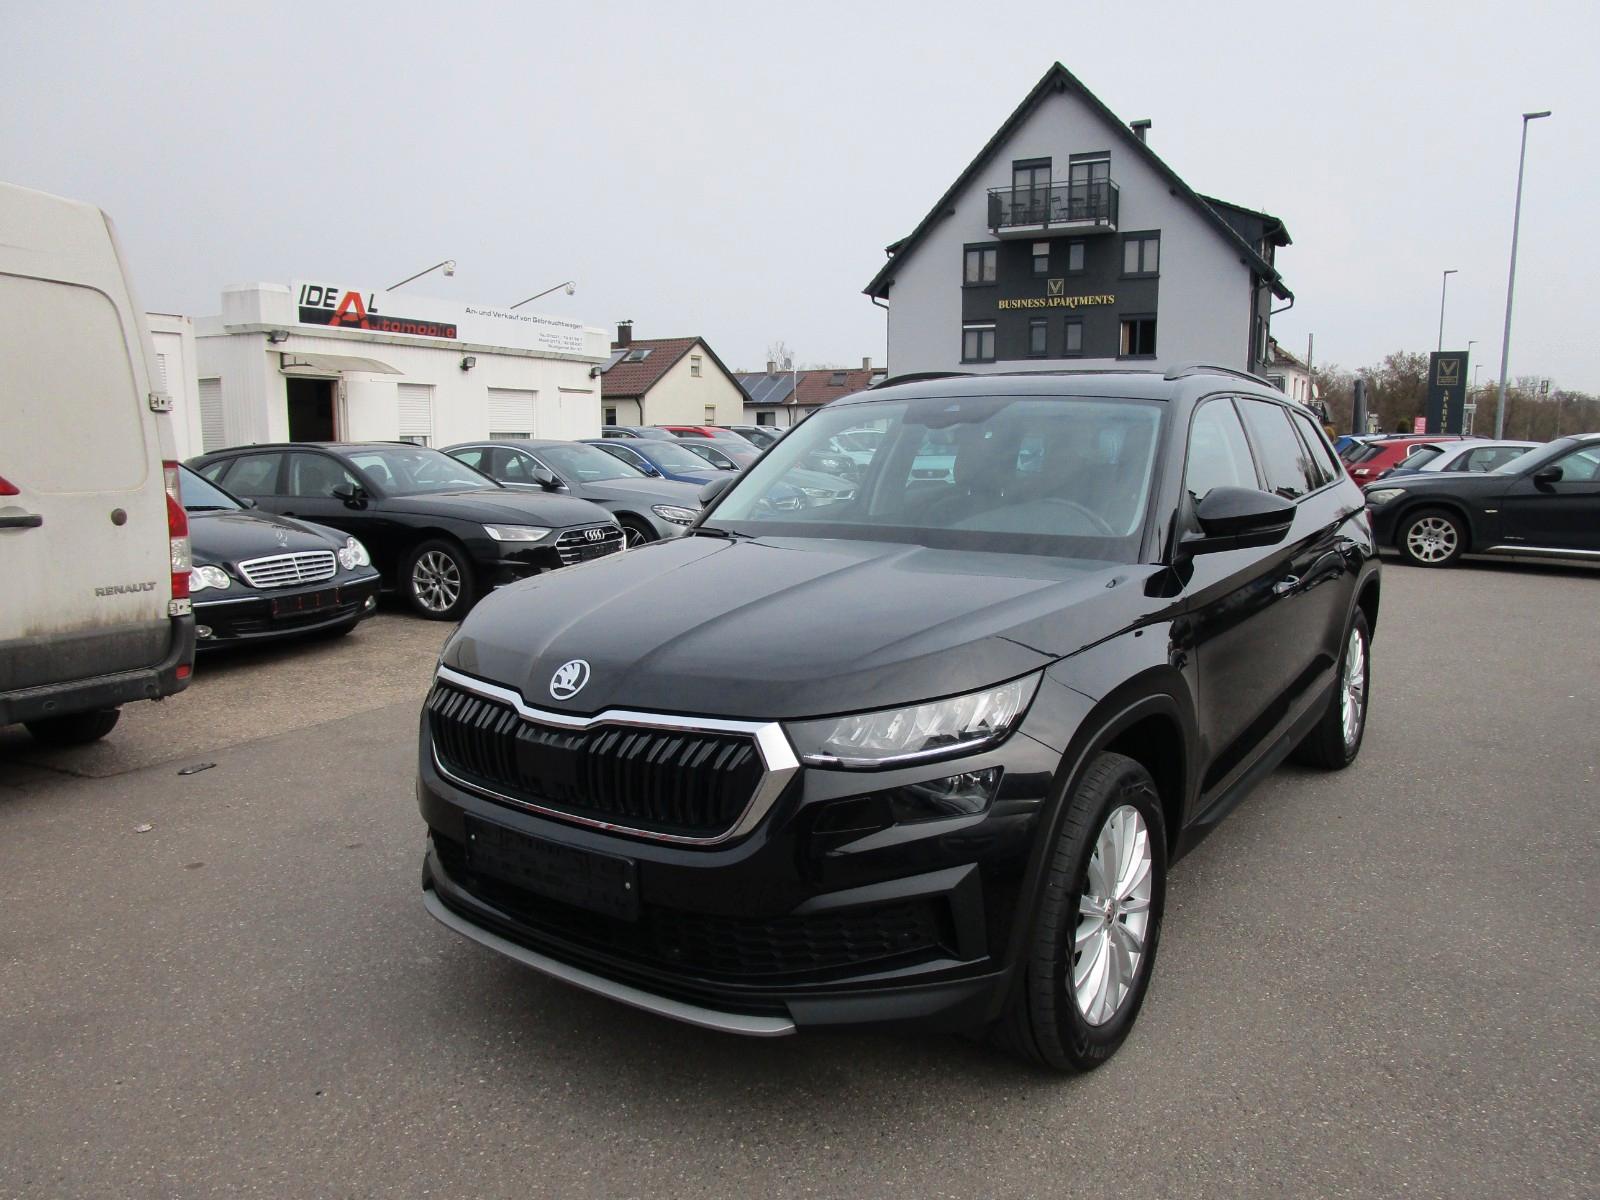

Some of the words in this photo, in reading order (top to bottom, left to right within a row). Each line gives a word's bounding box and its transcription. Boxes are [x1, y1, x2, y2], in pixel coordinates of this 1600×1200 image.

[999, 298, 1046, 310] BUSINESS
[1046, 294, 1115, 309] APARTMENTS
[479, 309, 492, 317] und
[492, 311, 519, 321] Verkauf
[532, 316, 583, 329] Gebrauchtwagen
[95, 581, 157, 597] RENAULT
